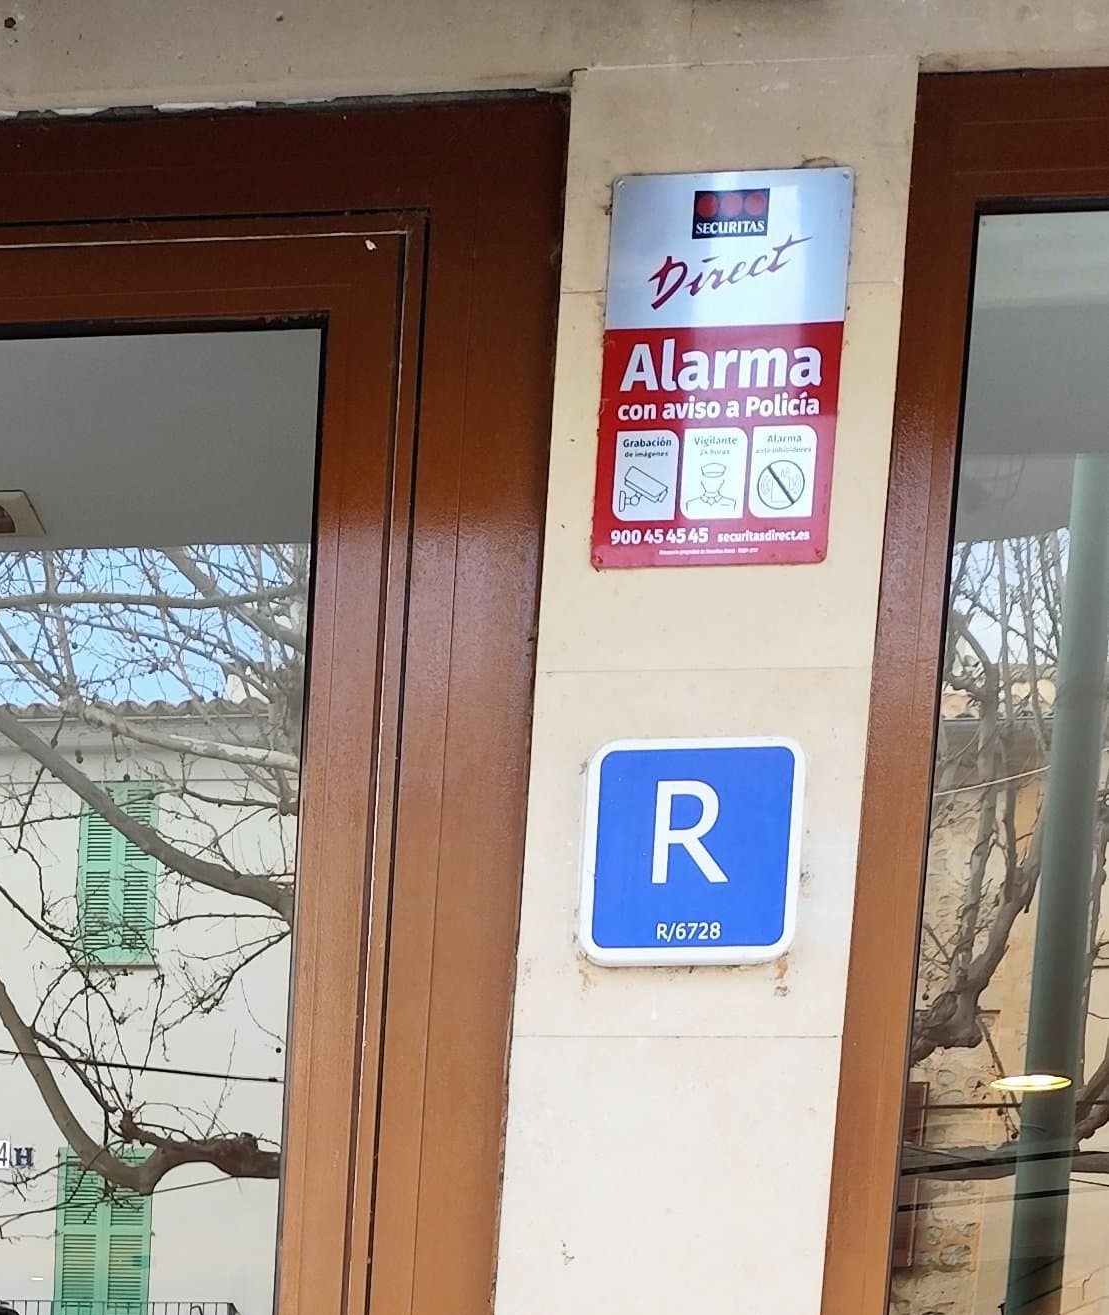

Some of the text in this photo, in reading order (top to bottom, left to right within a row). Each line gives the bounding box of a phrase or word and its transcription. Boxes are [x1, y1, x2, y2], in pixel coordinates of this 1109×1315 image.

[695, 220, 766, 235] SECURITAS
[648, 233, 813, 310] Direct
[619, 337, 822, 392] Alarma
[617, 393, 820, 422] con aviso a Policía
[623, 436, 672, 448] Grabación
[694, 435, 738, 447] Vigilante
[767, 433, 802, 443] Alarma
[610, 527, 810, 545] 900 45 45 45 securitasdirect.es
[652, 780, 729, 884] R
[656, 922, 721, 942] R/6728
